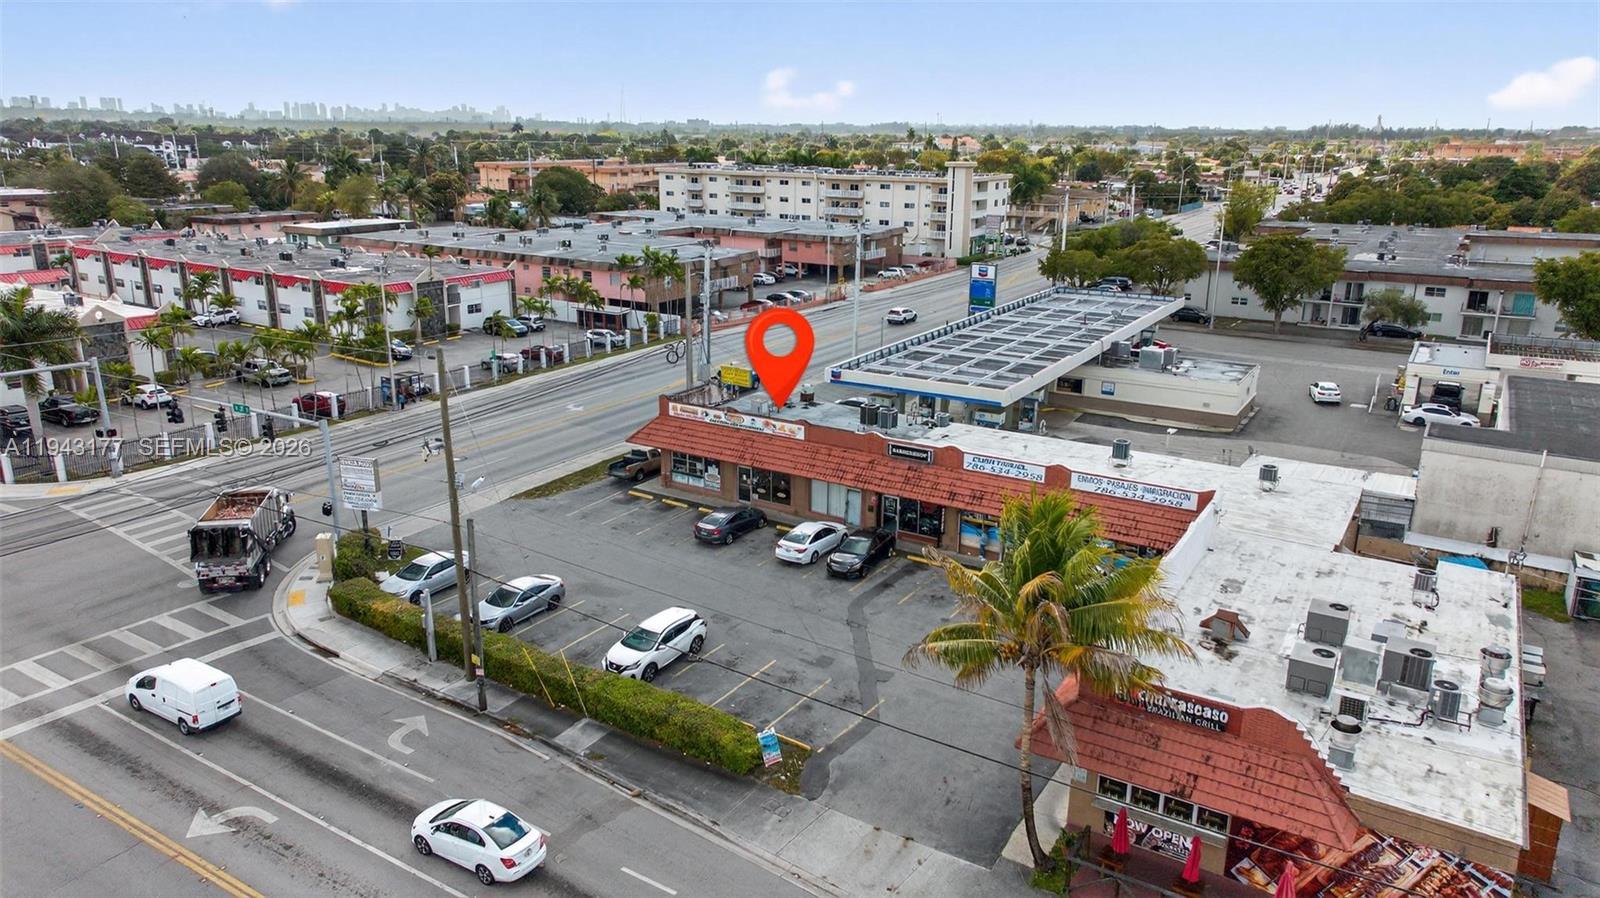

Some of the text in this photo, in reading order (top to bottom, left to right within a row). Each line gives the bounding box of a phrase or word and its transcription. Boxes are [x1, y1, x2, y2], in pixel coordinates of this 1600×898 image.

[1442, 368, 1460, 376] Enter
[965, 461, 1043, 481] 786-534-2958
[1195, 718, 1222, 732] GRILL
[1151, 827, 1193, 851] OPEN
